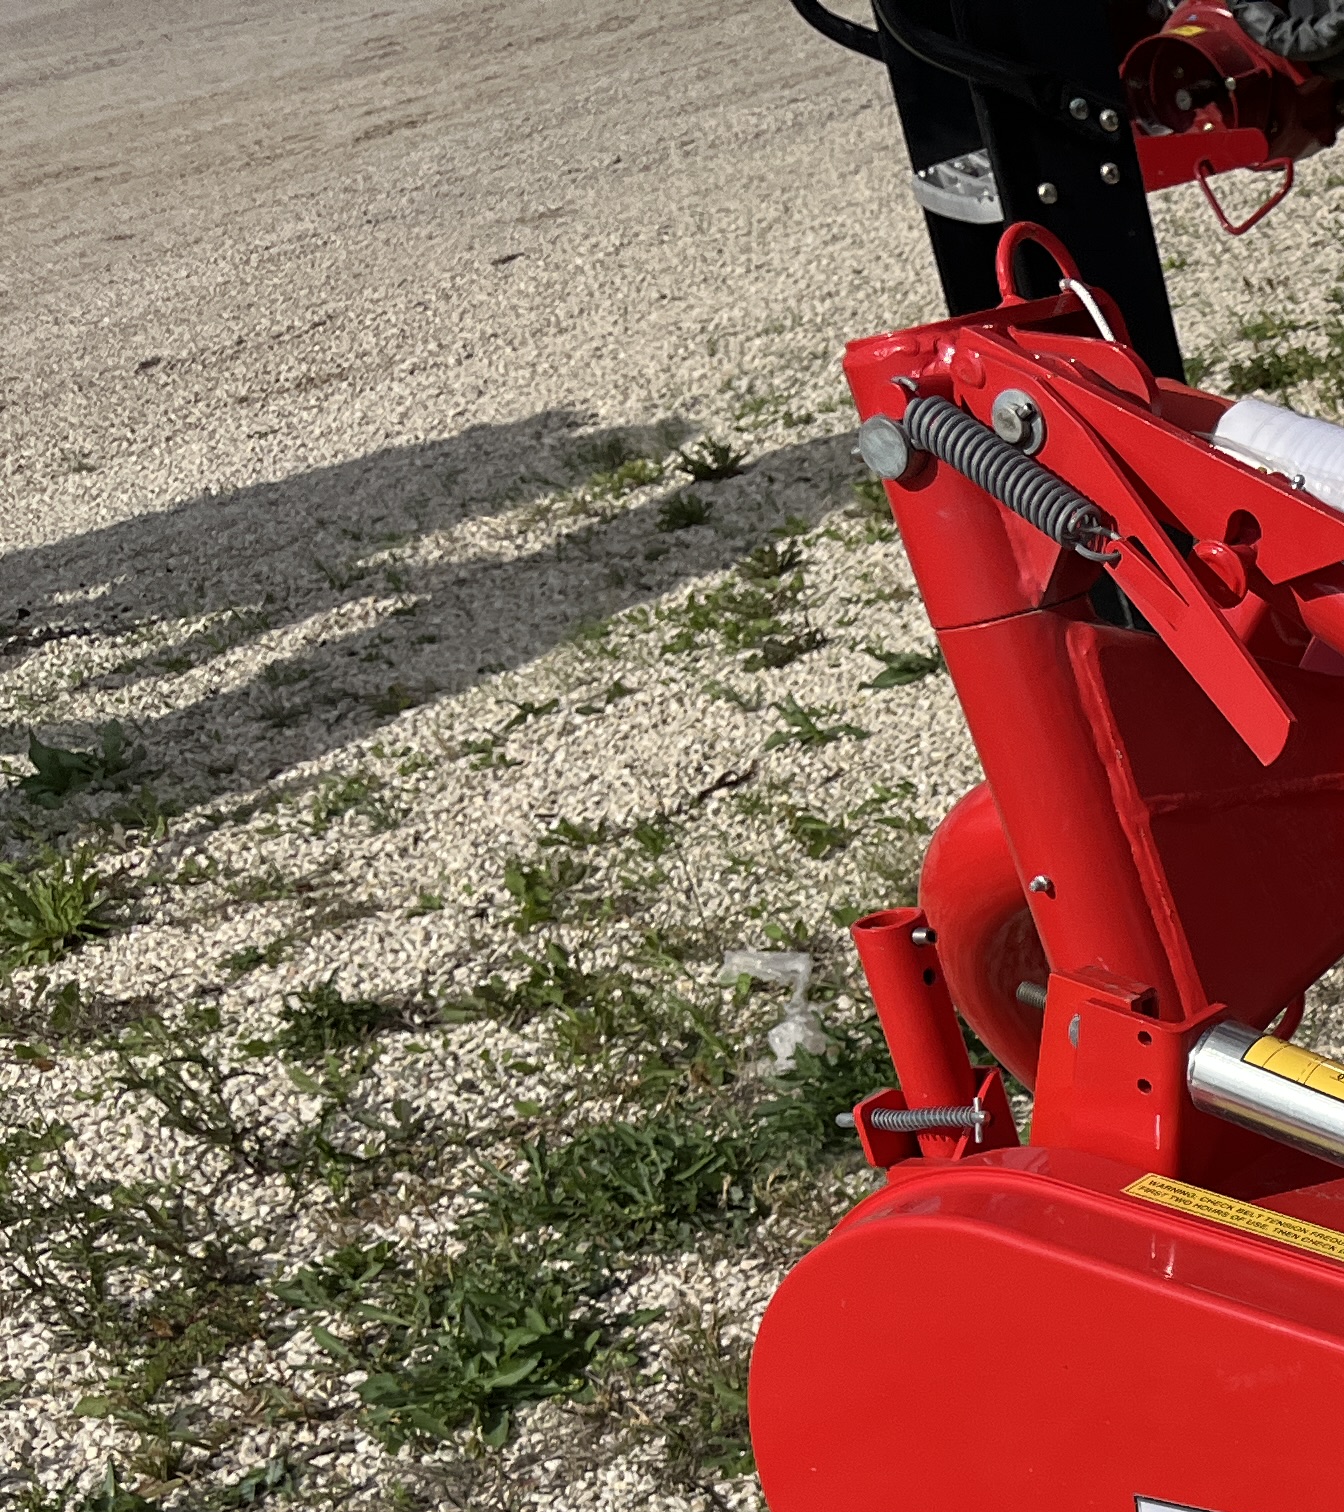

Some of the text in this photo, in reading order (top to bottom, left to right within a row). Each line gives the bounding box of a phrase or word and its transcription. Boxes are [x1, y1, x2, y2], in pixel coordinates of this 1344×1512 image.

[1138, 1185, 1169, 1198] FIRST
[1169, 1194, 1193, 1206] TWO
[1192, 1202, 1230, 1218] HOURS
[1229, 1214, 1246, 1222] OF
[1273, 1226, 1301, 1240] THEN
[1300, 1236, 1337, 1252] CHECK
[1199, 1196, 1235, 1211] CHECK
[1235, 1207, 1264, 1220] BELT
[1265, 1216, 1309, 1234] TENSION
